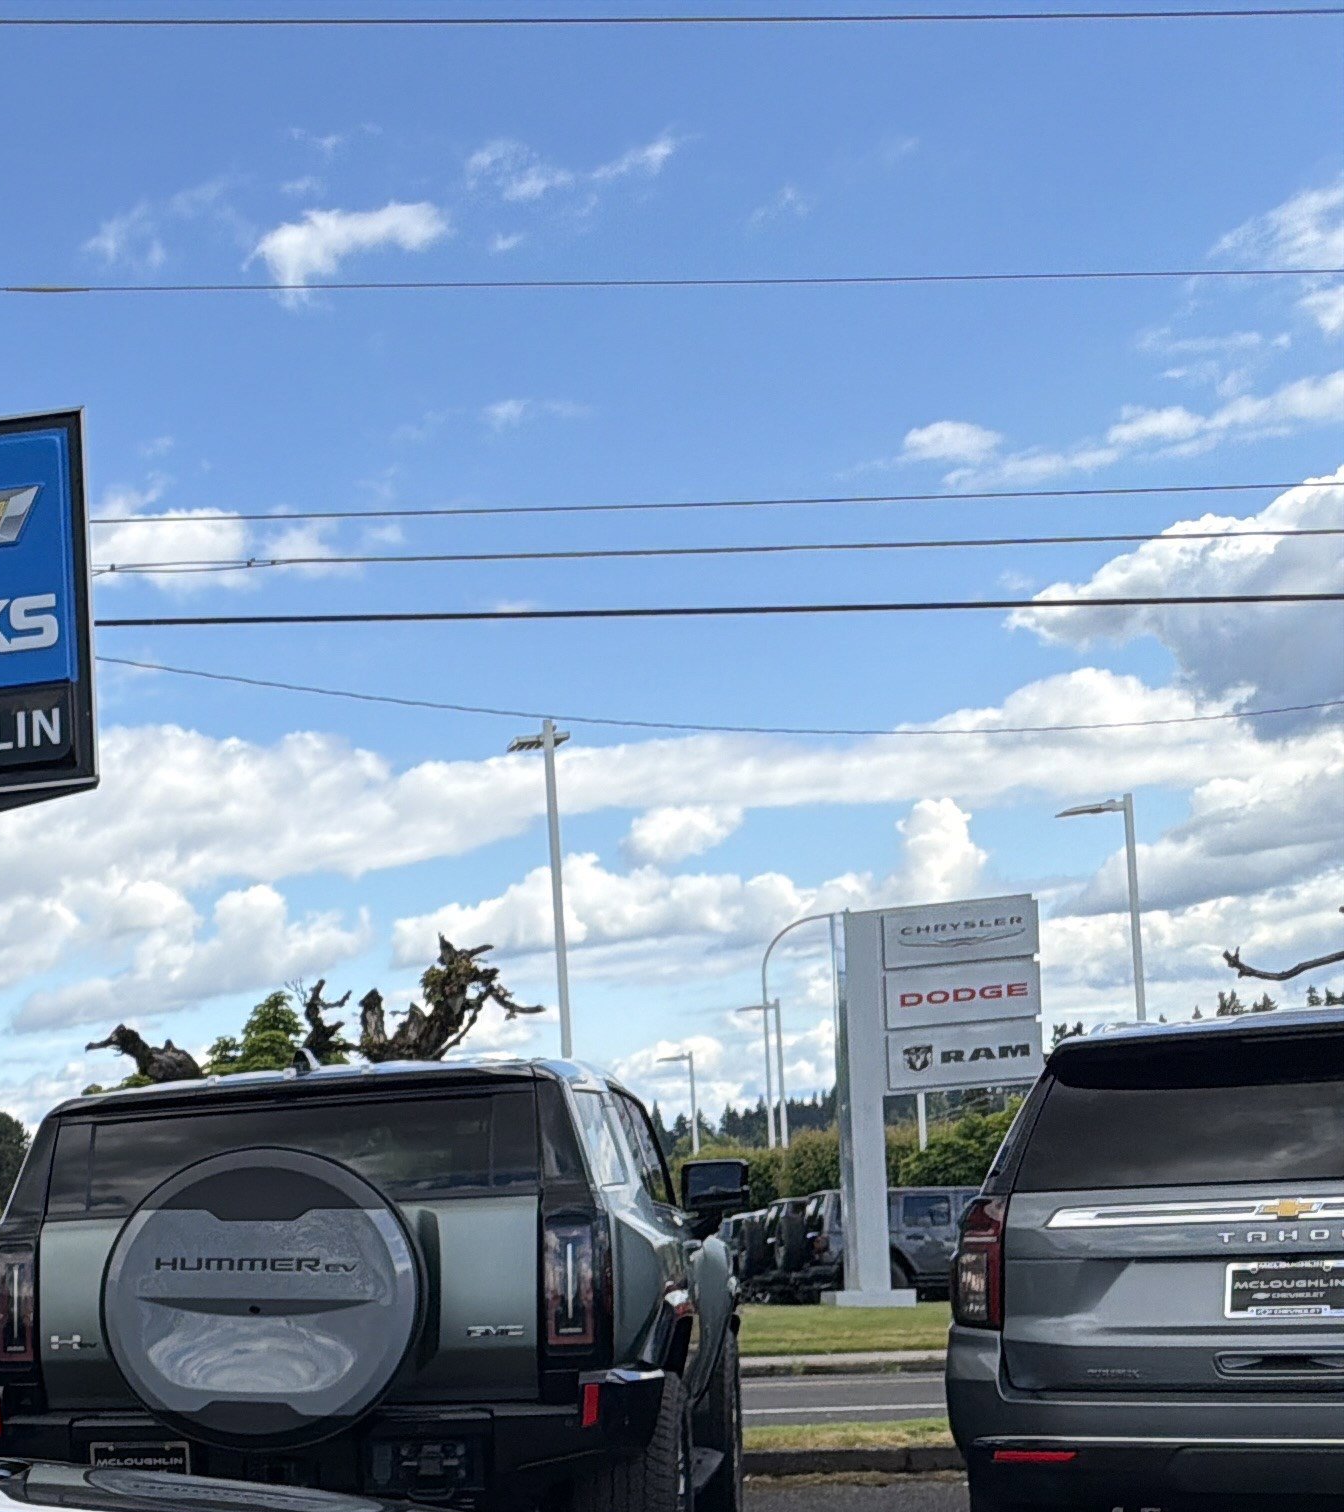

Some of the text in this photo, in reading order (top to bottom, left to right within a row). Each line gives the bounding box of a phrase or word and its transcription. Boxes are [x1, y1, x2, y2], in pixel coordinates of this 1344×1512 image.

[900, 915, 1024, 936] CHRYSLER
[899, 981, 1029, 1009] DODGE
[940, 1043, 1031, 1065] RAM
[1217, 1228, 1344, 1243] TAHO
[154, 1256, 358, 1273] HUMMER EV
[466, 1324, 525, 1337] GMC
[96, 1457, 184, 1468] MCLOUGHLIN
